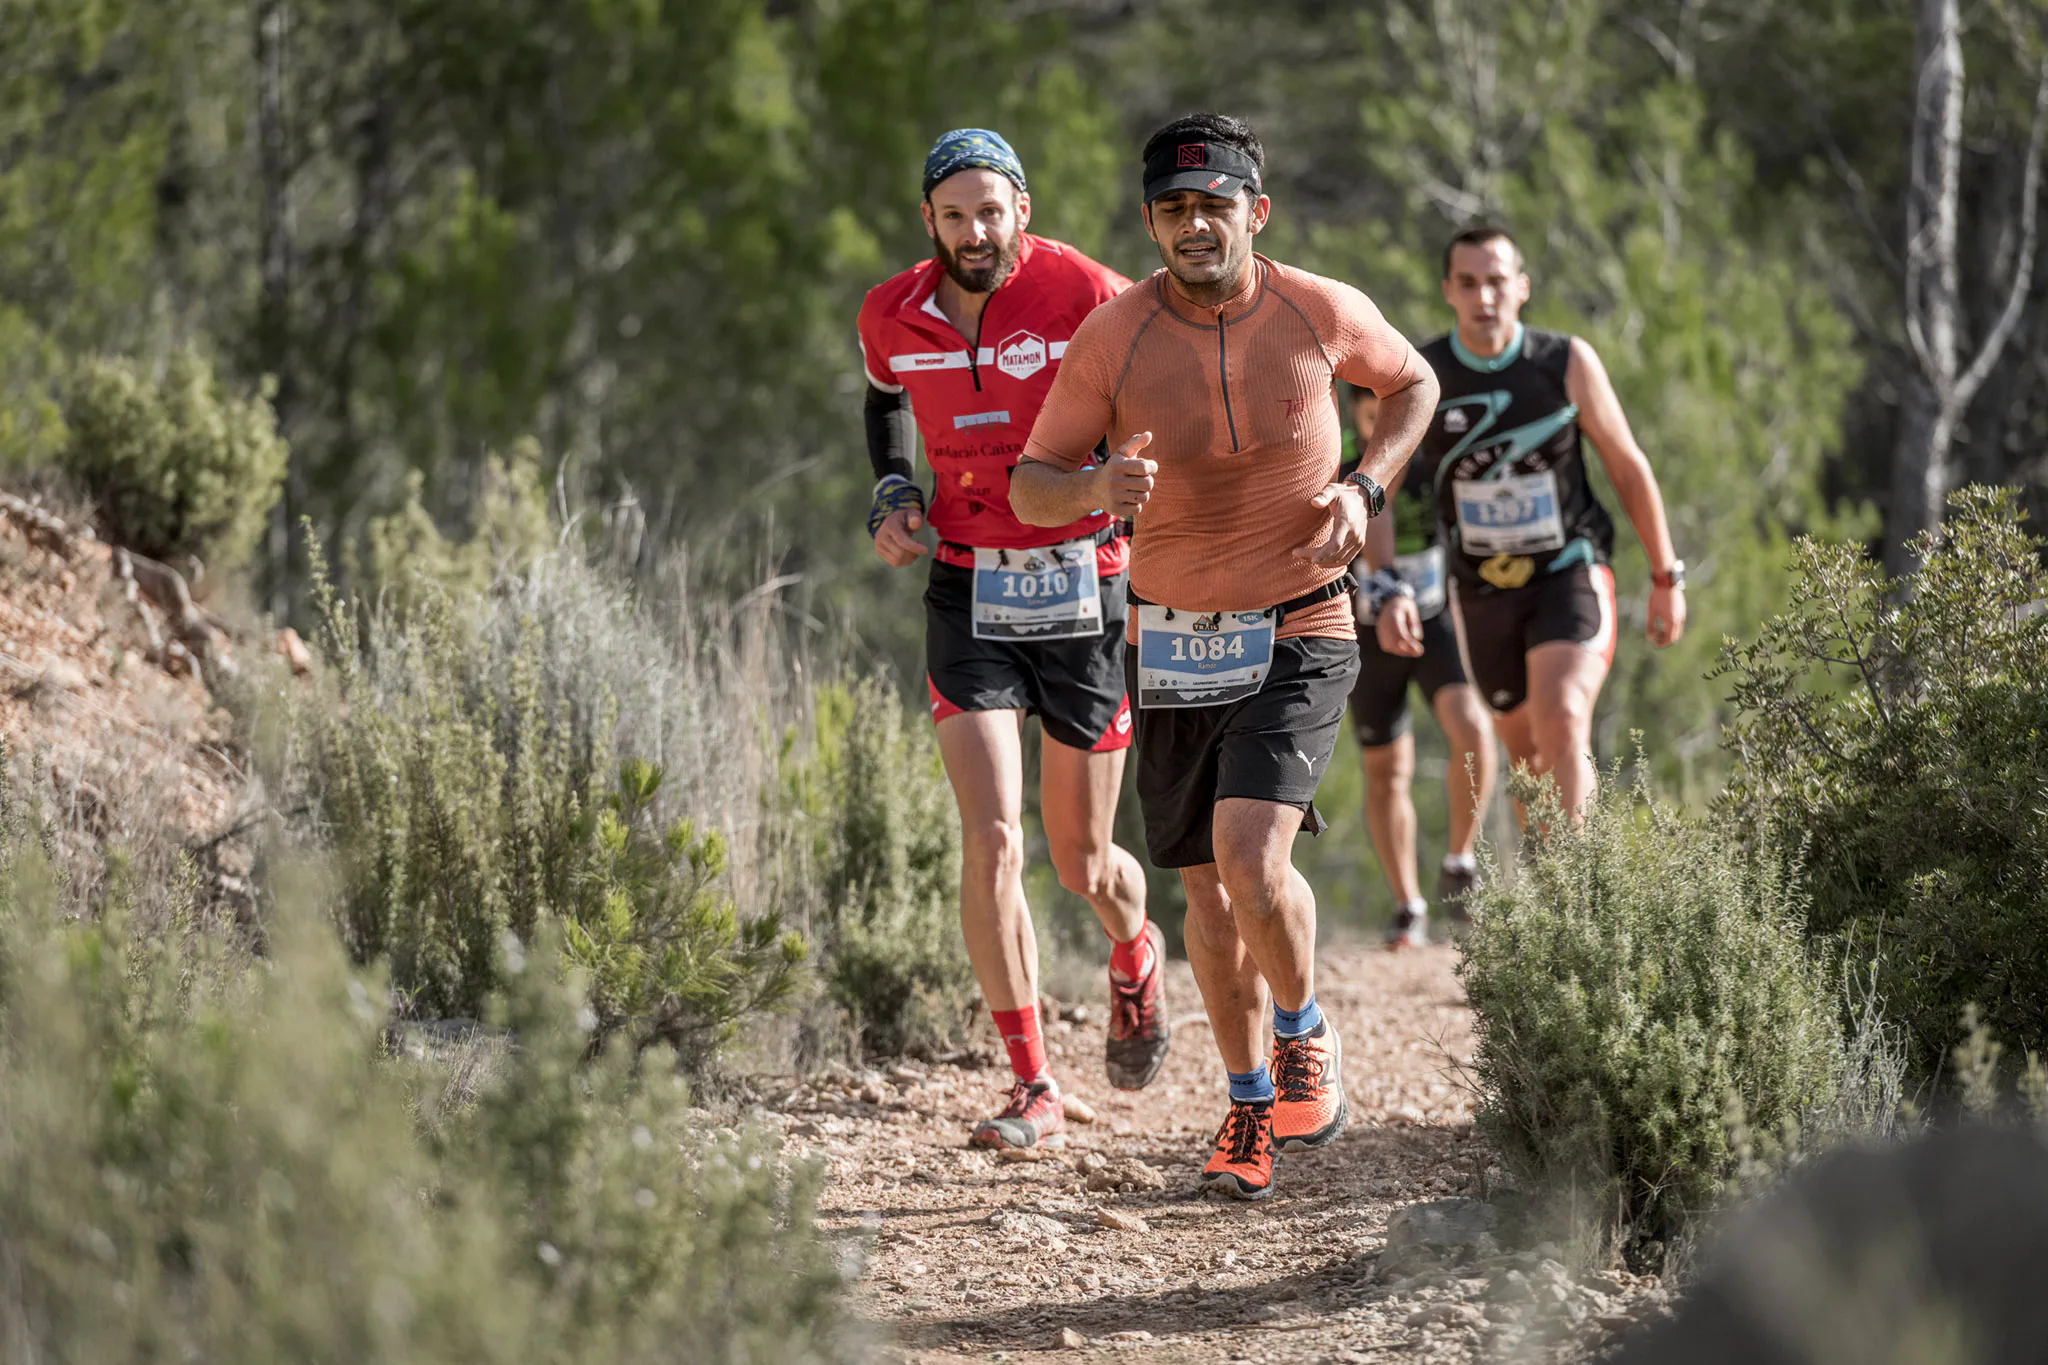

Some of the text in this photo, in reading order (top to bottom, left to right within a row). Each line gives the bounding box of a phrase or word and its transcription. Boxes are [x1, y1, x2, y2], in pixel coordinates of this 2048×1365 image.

[1002, 351, 1041, 366] MATAMON
[980, 441, 1022, 457] Caixa
[1002, 572, 1069, 598] 1010
[1194, 623, 1218, 631] TRAIL
[1170, 634, 1245, 662] 1084
